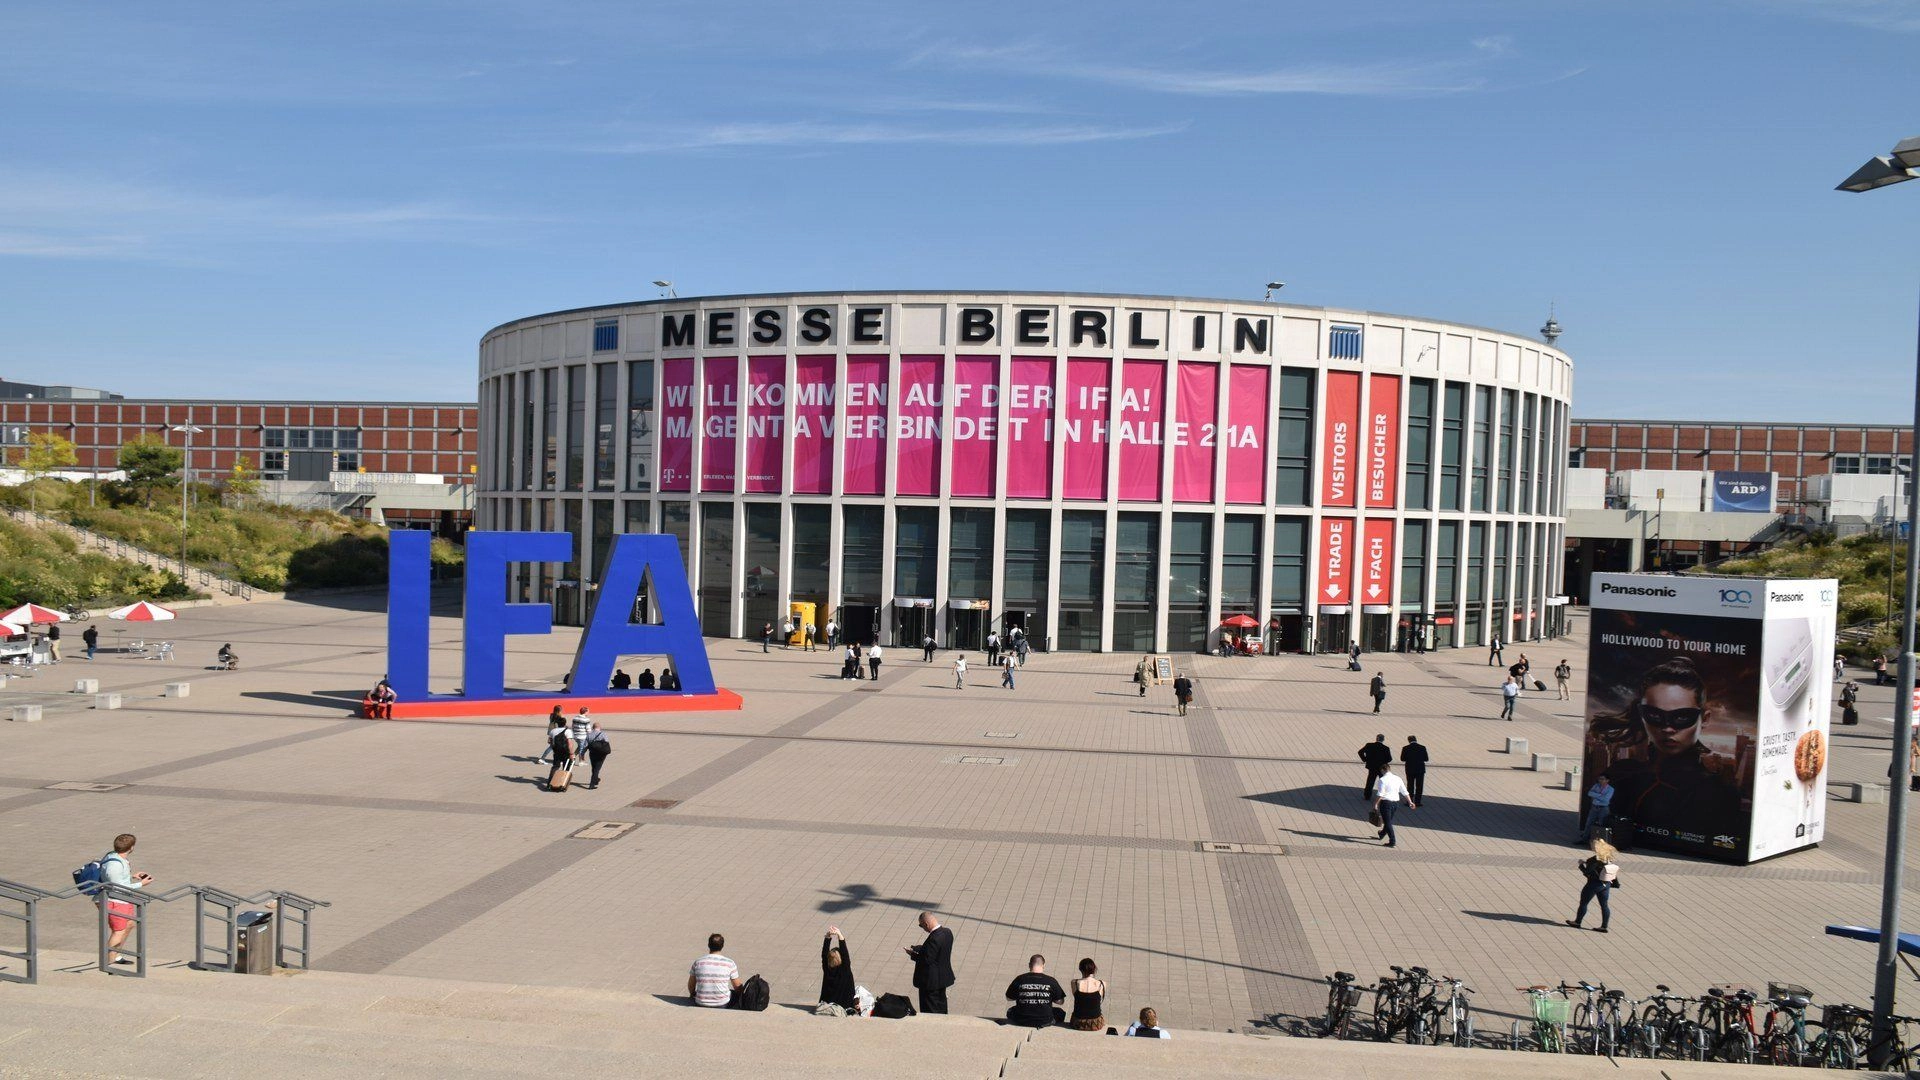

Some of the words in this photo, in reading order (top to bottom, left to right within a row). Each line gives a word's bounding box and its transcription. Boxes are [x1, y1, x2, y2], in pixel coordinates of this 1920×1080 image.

[662, 308, 883, 347] MESSE
[962, 308, 1267, 353] BERLIN
[666, 382, 887, 408] WILLKOMMEN
[904, 383, 972, 408] AUF
[981, 384, 1054, 409] DER
[1079, 386, 1150, 412] IFA!
[1092, 419, 1188, 446] HALLE
[1200, 423, 1258, 449] 21A
[1331, 421, 1347, 500] VISITORS
[1372, 413, 1387, 501] BESUCHER
[1731, 485, 1758, 494] ARD
[1328, 522, 1343, 579] TRADE
[1370, 537, 1383, 580] FACH
[1601, 582, 1677, 598] Panasonic
[1718, 589, 1752, 604] 100
[1770, 591, 1804, 603] Panasonic
[387, 529, 719, 703] IFA
[1602, 633, 1664, 649] HOLLYWOOD
[1667, 638, 1680, 650] TO
[1683, 640, 1711, 653] YOUR
[1715, 642, 1746, 656] HOME
[1646, 826, 1670, 836] OLED
[1713, 834, 1735, 844] 4K
